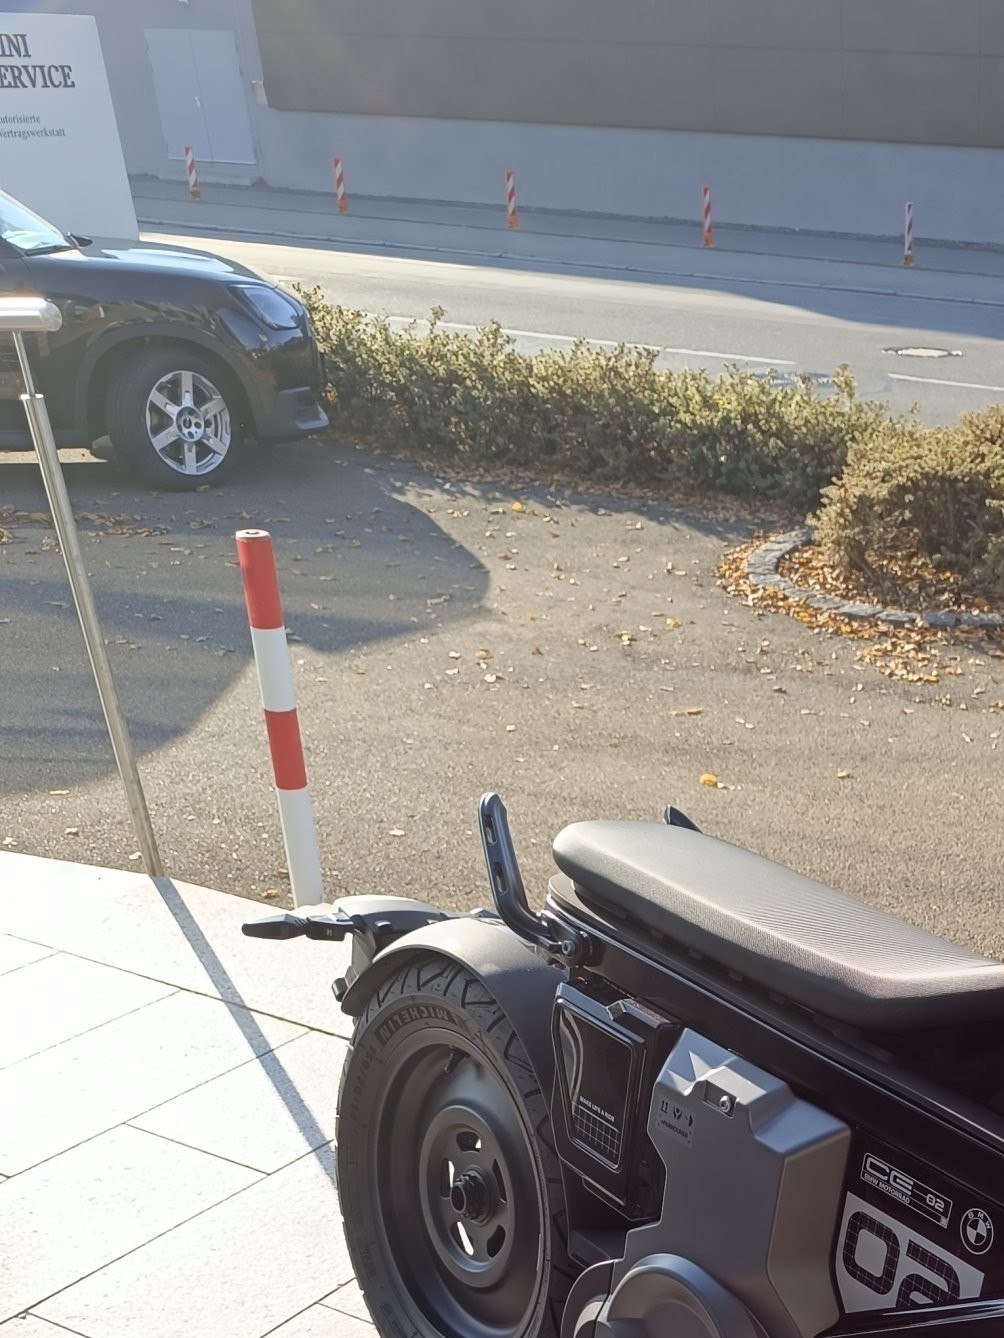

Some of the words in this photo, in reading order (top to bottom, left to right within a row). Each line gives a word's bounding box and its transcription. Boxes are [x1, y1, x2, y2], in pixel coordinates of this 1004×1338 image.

[0, 113, 41, 125] utorisierte
[379, 1005, 449, 1043] MICHELIN
[864, 1173, 879, 1186] BMW
[878, 1181, 911, 1204] MOTORRAD
